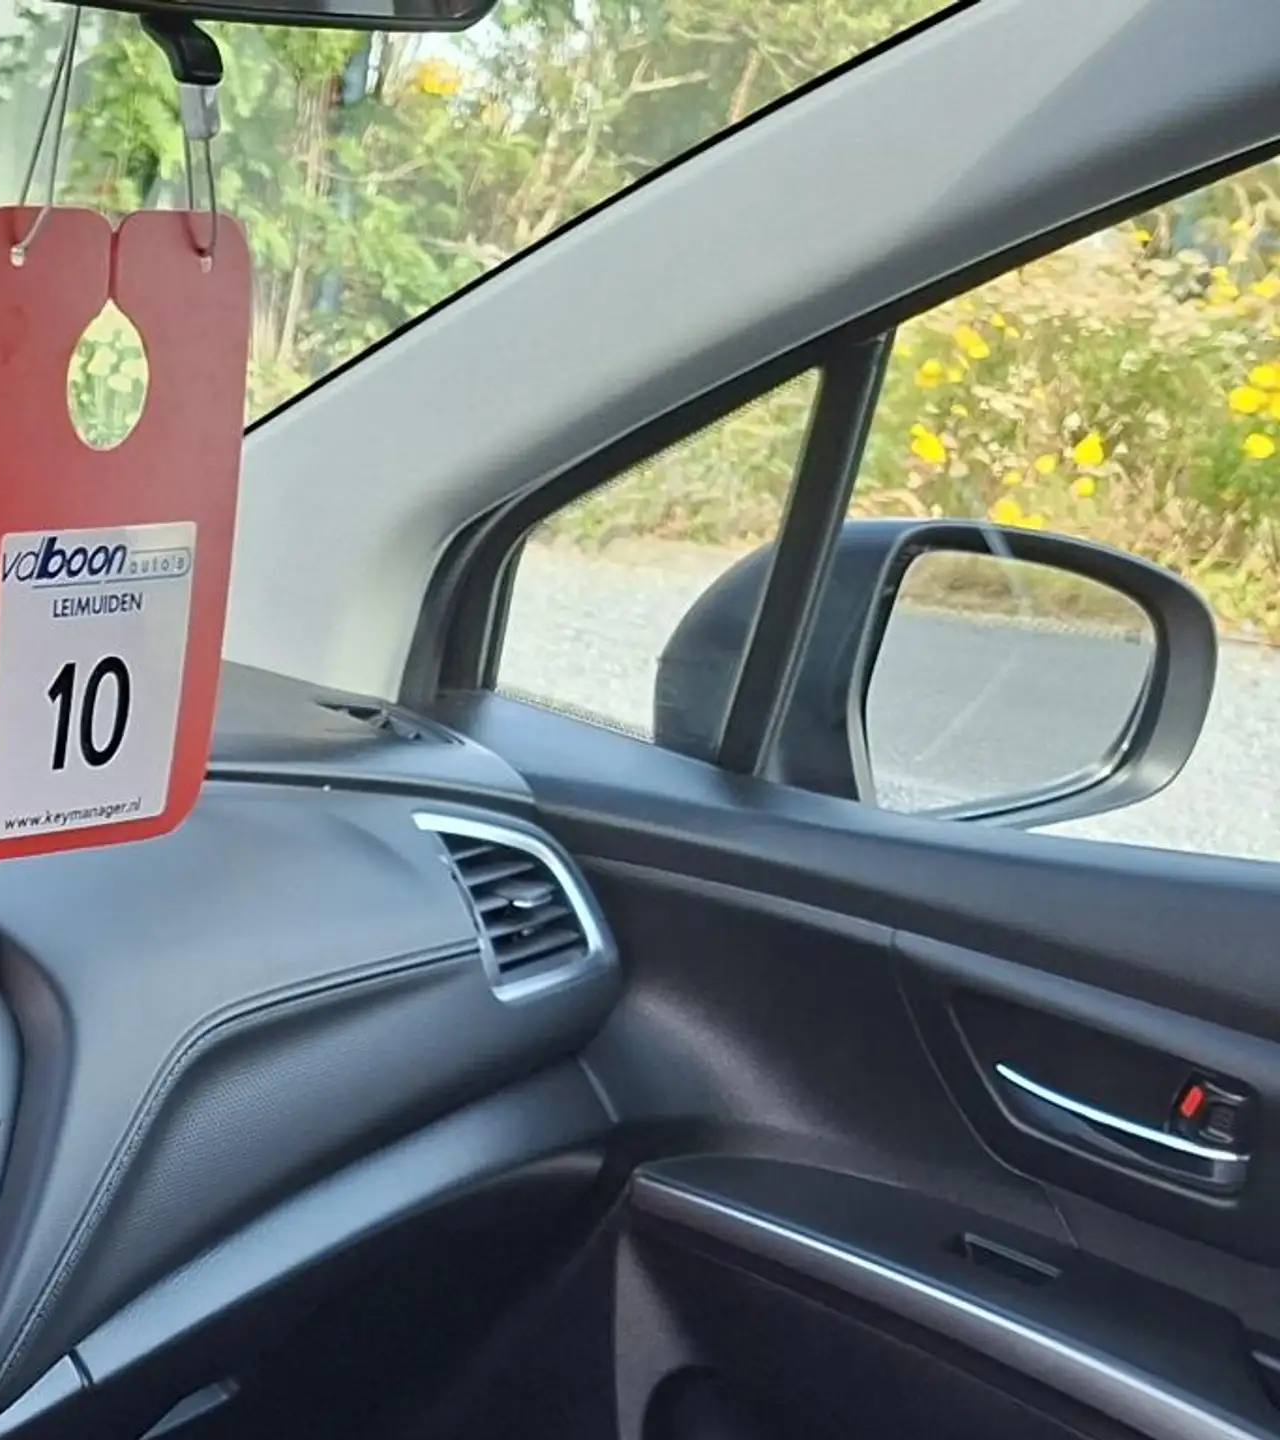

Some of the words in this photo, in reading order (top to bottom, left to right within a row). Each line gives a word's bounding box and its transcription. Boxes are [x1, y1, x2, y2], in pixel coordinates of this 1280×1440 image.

[52, 592, 143, 619] LEIMUIDEN
[47, 655, 131, 770] 10
[4, 796, 142, 831] www.keymanager.nl
